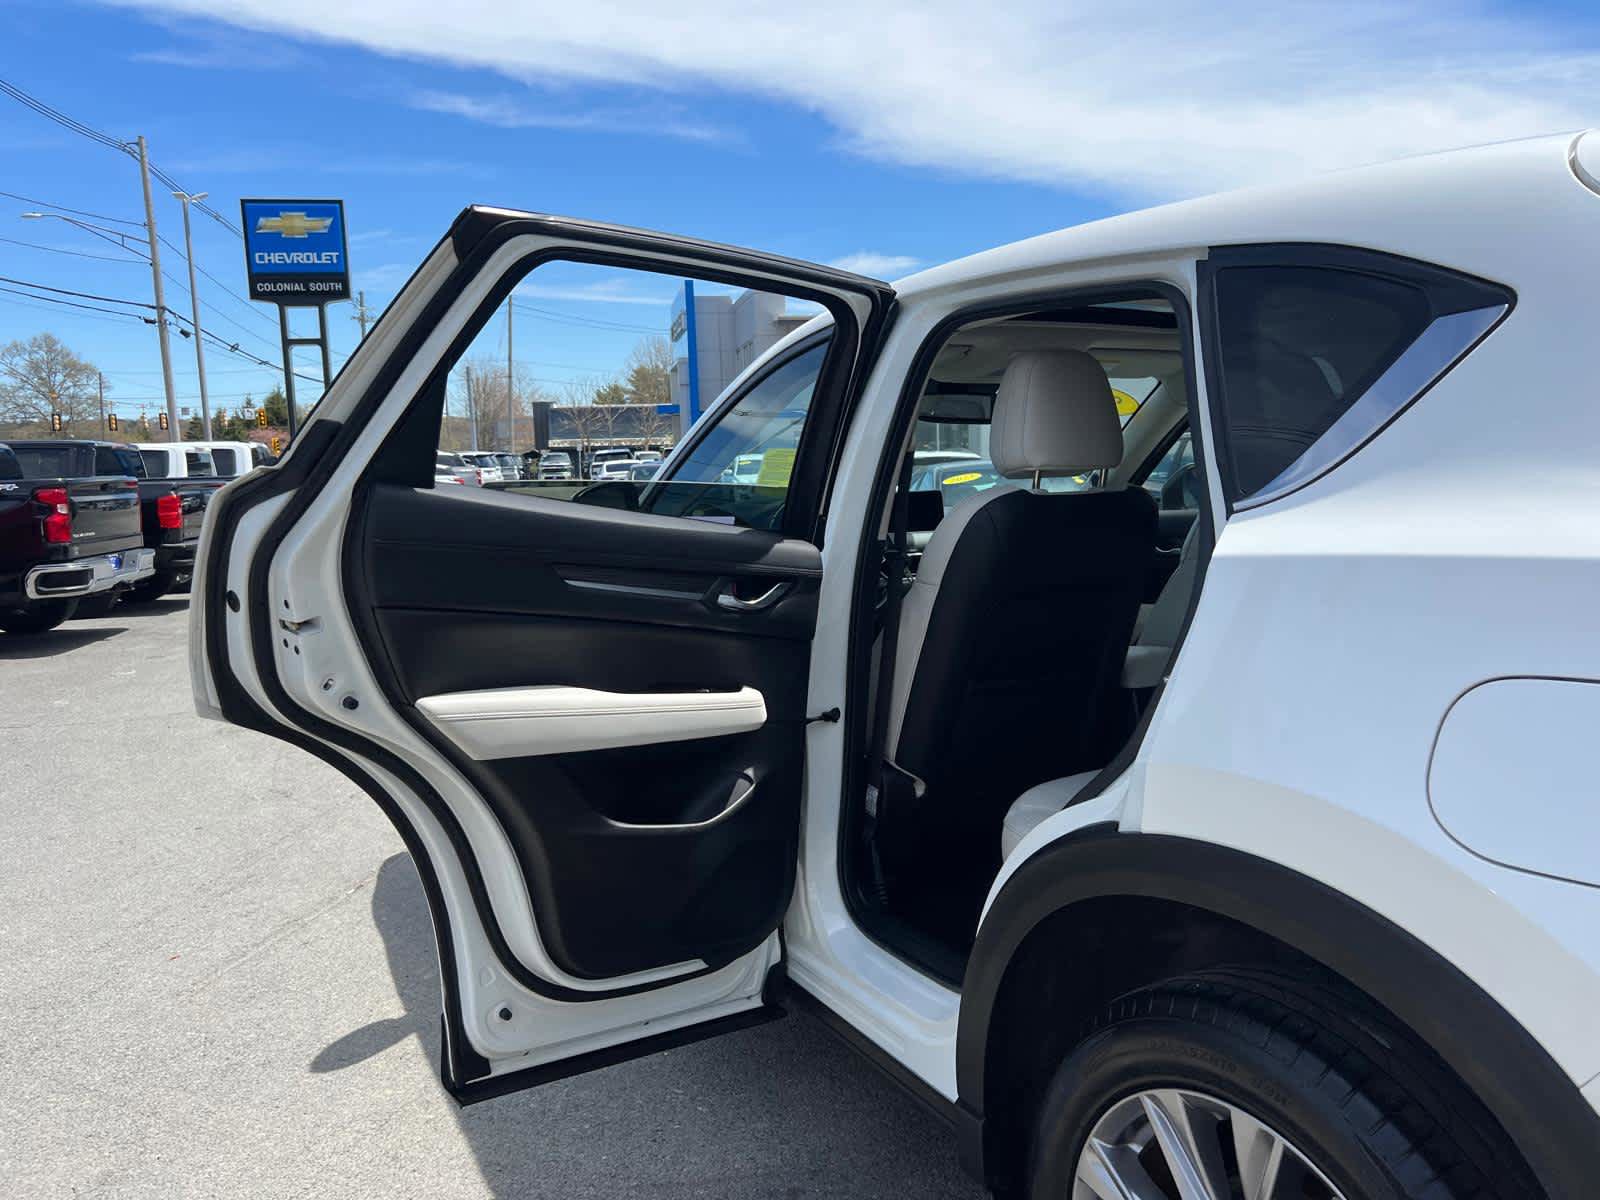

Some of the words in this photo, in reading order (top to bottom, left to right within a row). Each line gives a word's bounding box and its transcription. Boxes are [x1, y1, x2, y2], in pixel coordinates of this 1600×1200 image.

[255, 252, 339, 263] CHEVROLET
[256, 282, 306, 291] COLONIAL
[309, 282, 342, 291] SOUTH
